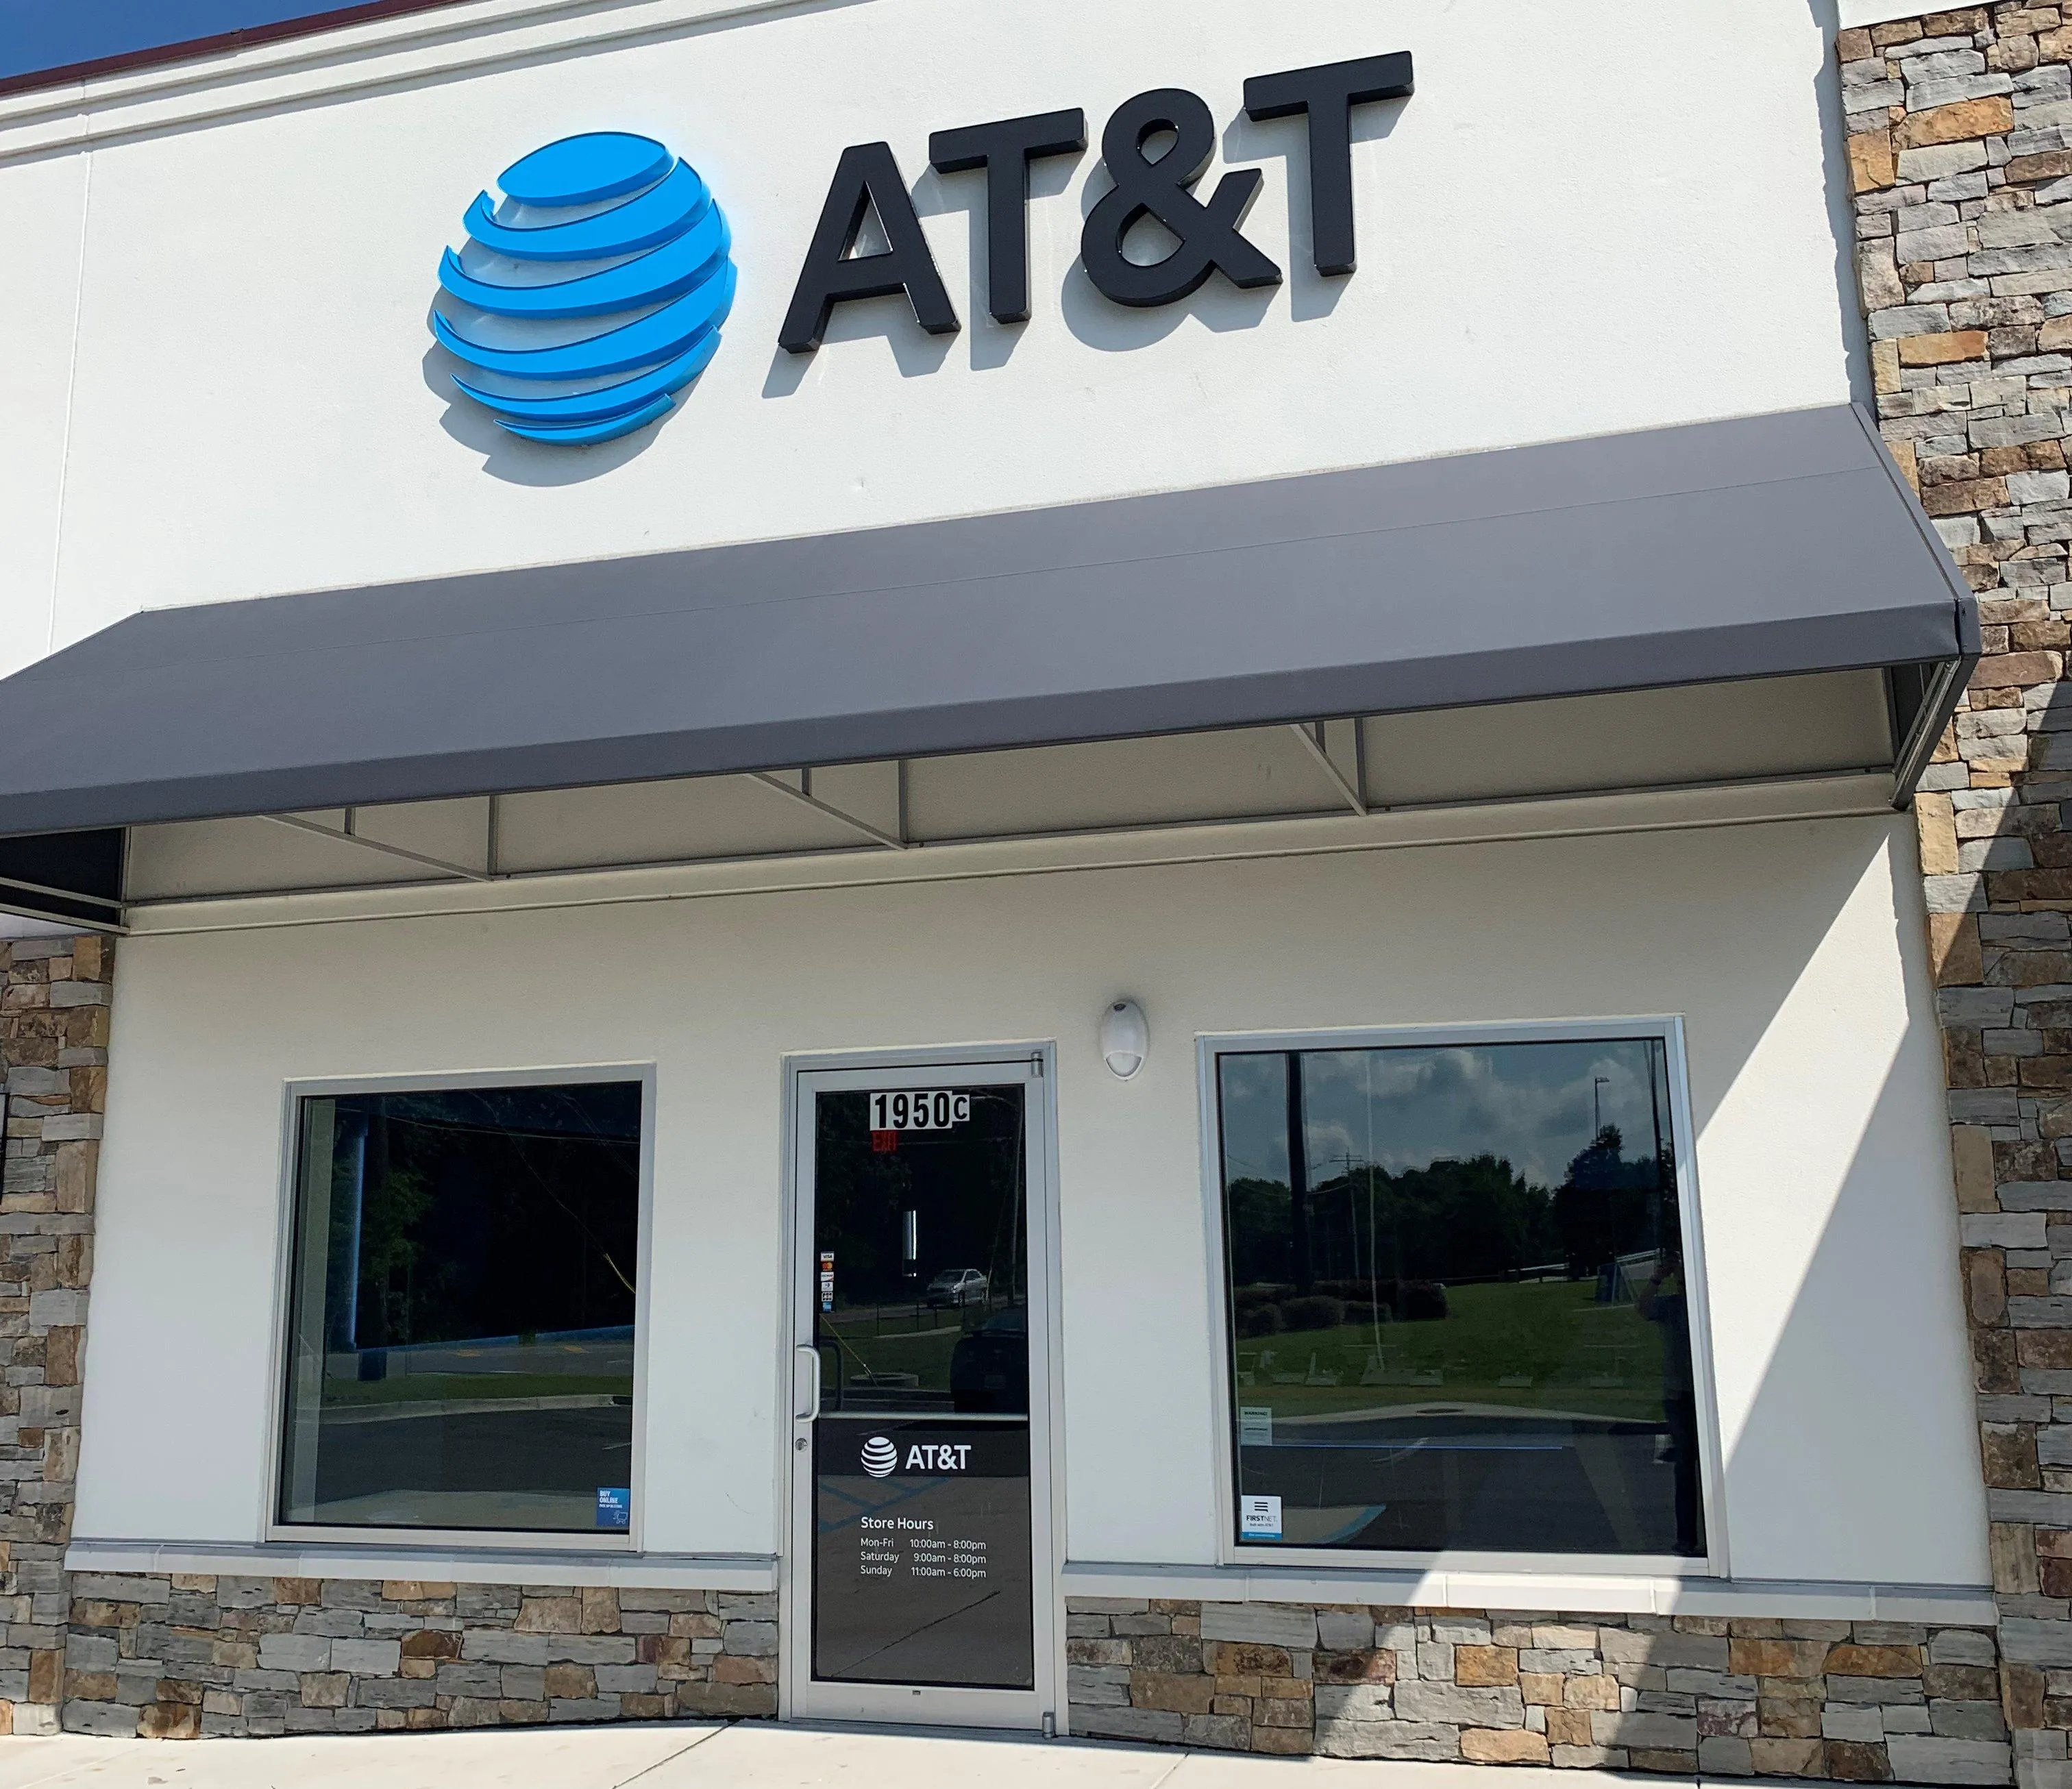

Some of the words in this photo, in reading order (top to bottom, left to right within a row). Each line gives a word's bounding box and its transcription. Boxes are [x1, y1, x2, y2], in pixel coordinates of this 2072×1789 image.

[778, 50, 1414, 353] AT&T
[905, 1444, 972, 1470] AT&T
[861, 1516, 894, 1529] Store
[898, 1518, 934, 1530] Hours
[861, 1538, 893, 1547] Mon-Fri
[910, 1539, 946, 1549] 10:00am
[953, 1540, 986, 1551] 8:00pm
[861, 1551, 899, 1563] Saturday
[913, 1553, 946, 1562] 9:00am
[953, 1554, 986, 1565] 8:00pm
[861, 1566, 892, 1577] Sunday
[911, 1567, 946, 1577] 11:00am
[953, 1568, 986, 1579] 6:00pm
